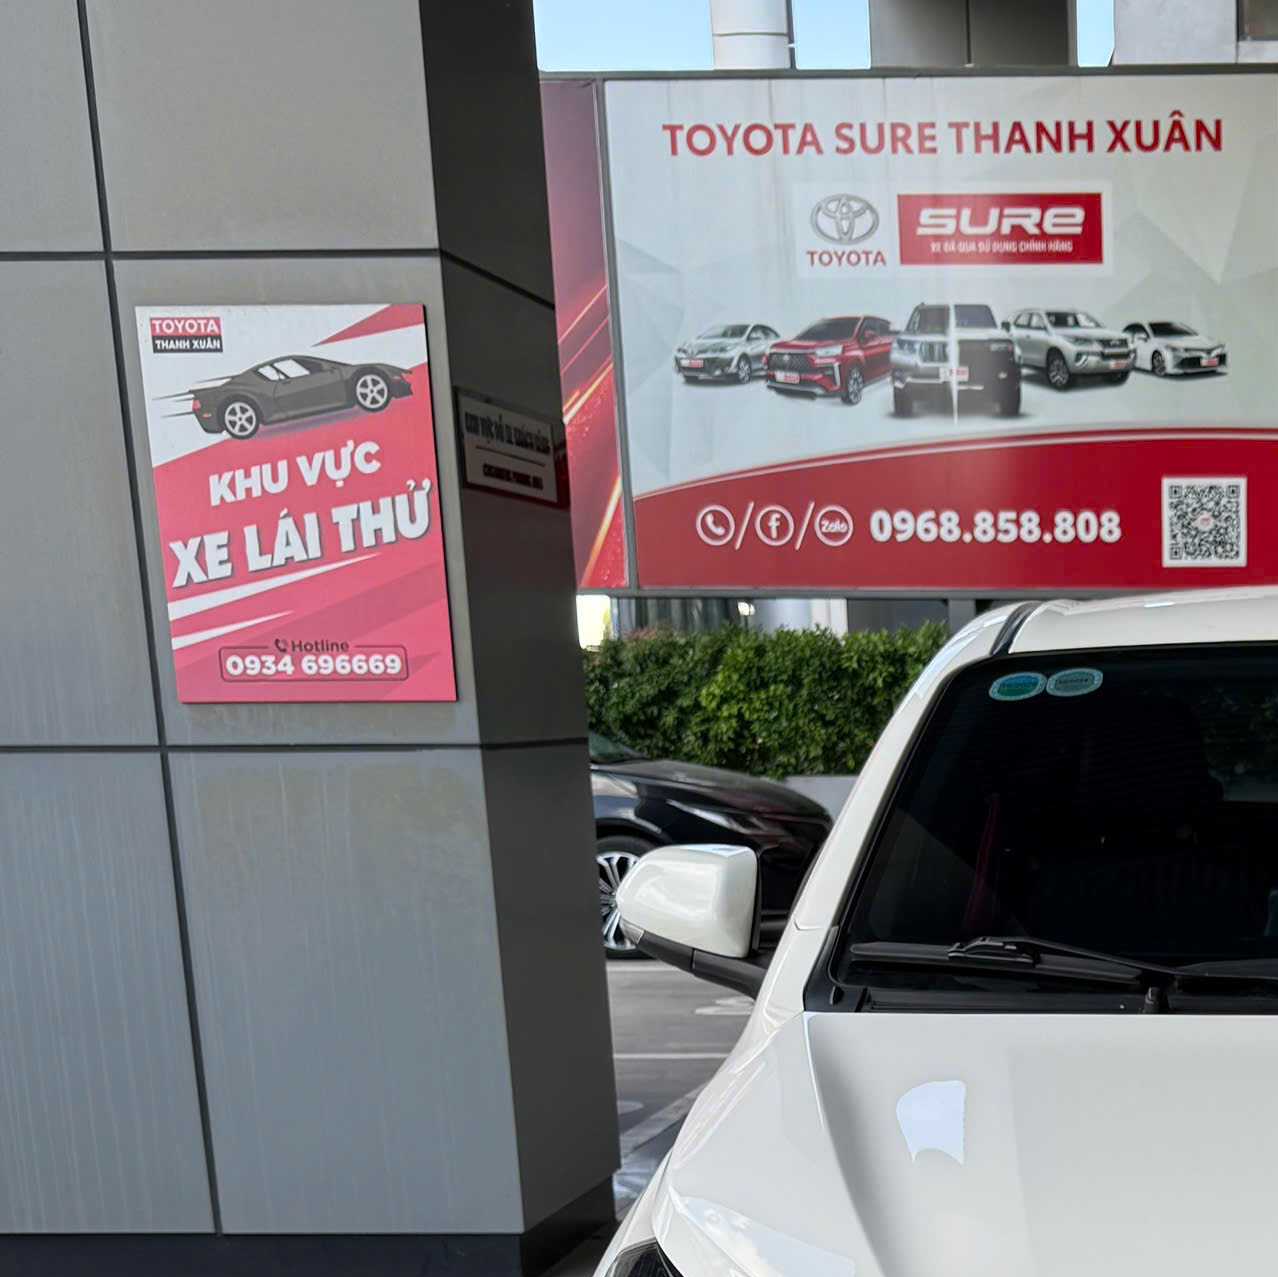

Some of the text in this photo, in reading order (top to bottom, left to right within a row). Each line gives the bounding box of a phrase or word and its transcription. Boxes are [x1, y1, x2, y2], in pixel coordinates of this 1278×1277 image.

[662, 109, 1222, 156] TOYOTA SURE THANH XUÂN
[806, 250, 887, 267] TOYOTA
[151, 319, 219, 334] TOYOTA
[155, 336, 221, 350] THANH XUÂN
[208, 440, 382, 506] KHU VỰC
[169, 479, 433, 589] XE LÁI THỬ
[870, 509, 1122, 544] 0968.858.808
[290, 638, 350, 653] Hotline
[226, 654, 402, 676] 0934 696669
